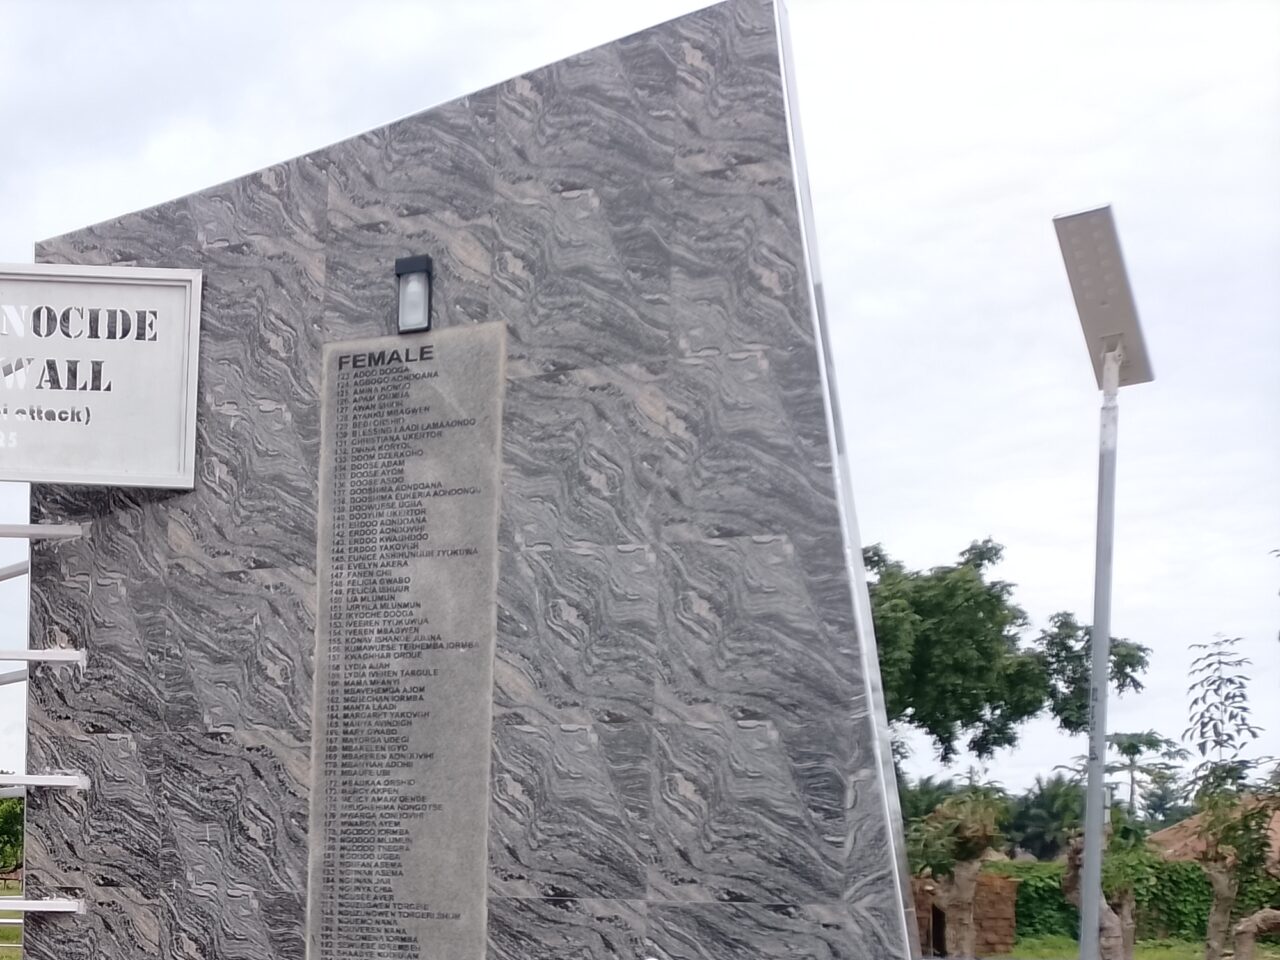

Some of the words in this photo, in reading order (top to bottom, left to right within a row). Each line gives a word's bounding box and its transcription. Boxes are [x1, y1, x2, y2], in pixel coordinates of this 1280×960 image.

[338, 345, 433, 370] FEMALE
[0, 356, 111, 392] WALL
[15, 404, 90, 425] attack)
[348, 528, 377, 537] ERDOO
[348, 544, 377, 553] ERDOO
[347, 561, 378, 570] EVELYN
[347, 570, 373, 578] FANEN
[346, 578, 377, 586] FELICIA
[346, 586, 377, 594] FELICIA
